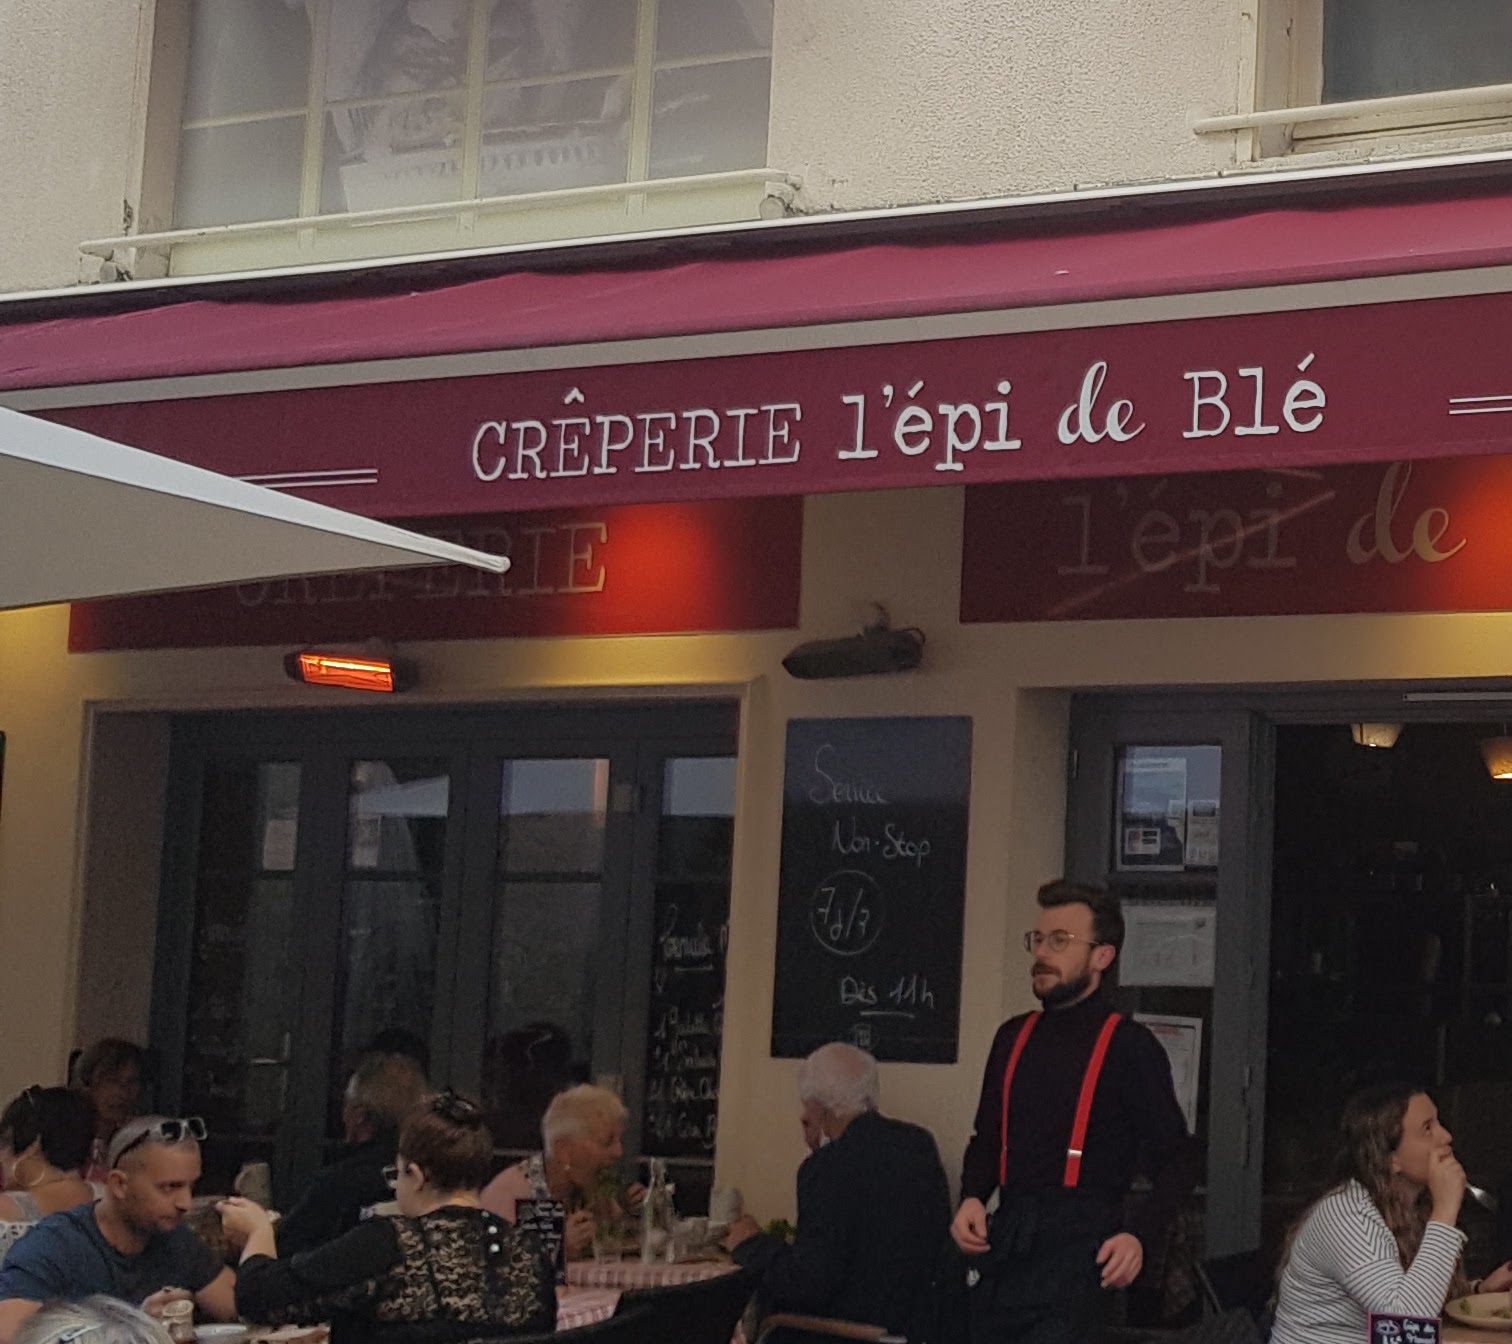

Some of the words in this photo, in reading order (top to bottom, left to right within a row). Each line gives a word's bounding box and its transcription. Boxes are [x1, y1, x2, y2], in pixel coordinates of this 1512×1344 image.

[471, 386, 802, 482] CRÊPERIE
[837, 379, 1022, 472] l'épi
[1056, 360, 1147, 445] de
[1182, 352, 1327, 440] Blé
[1056, 478, 1298, 594] l'épi
[1345, 460, 1468, 565] de
